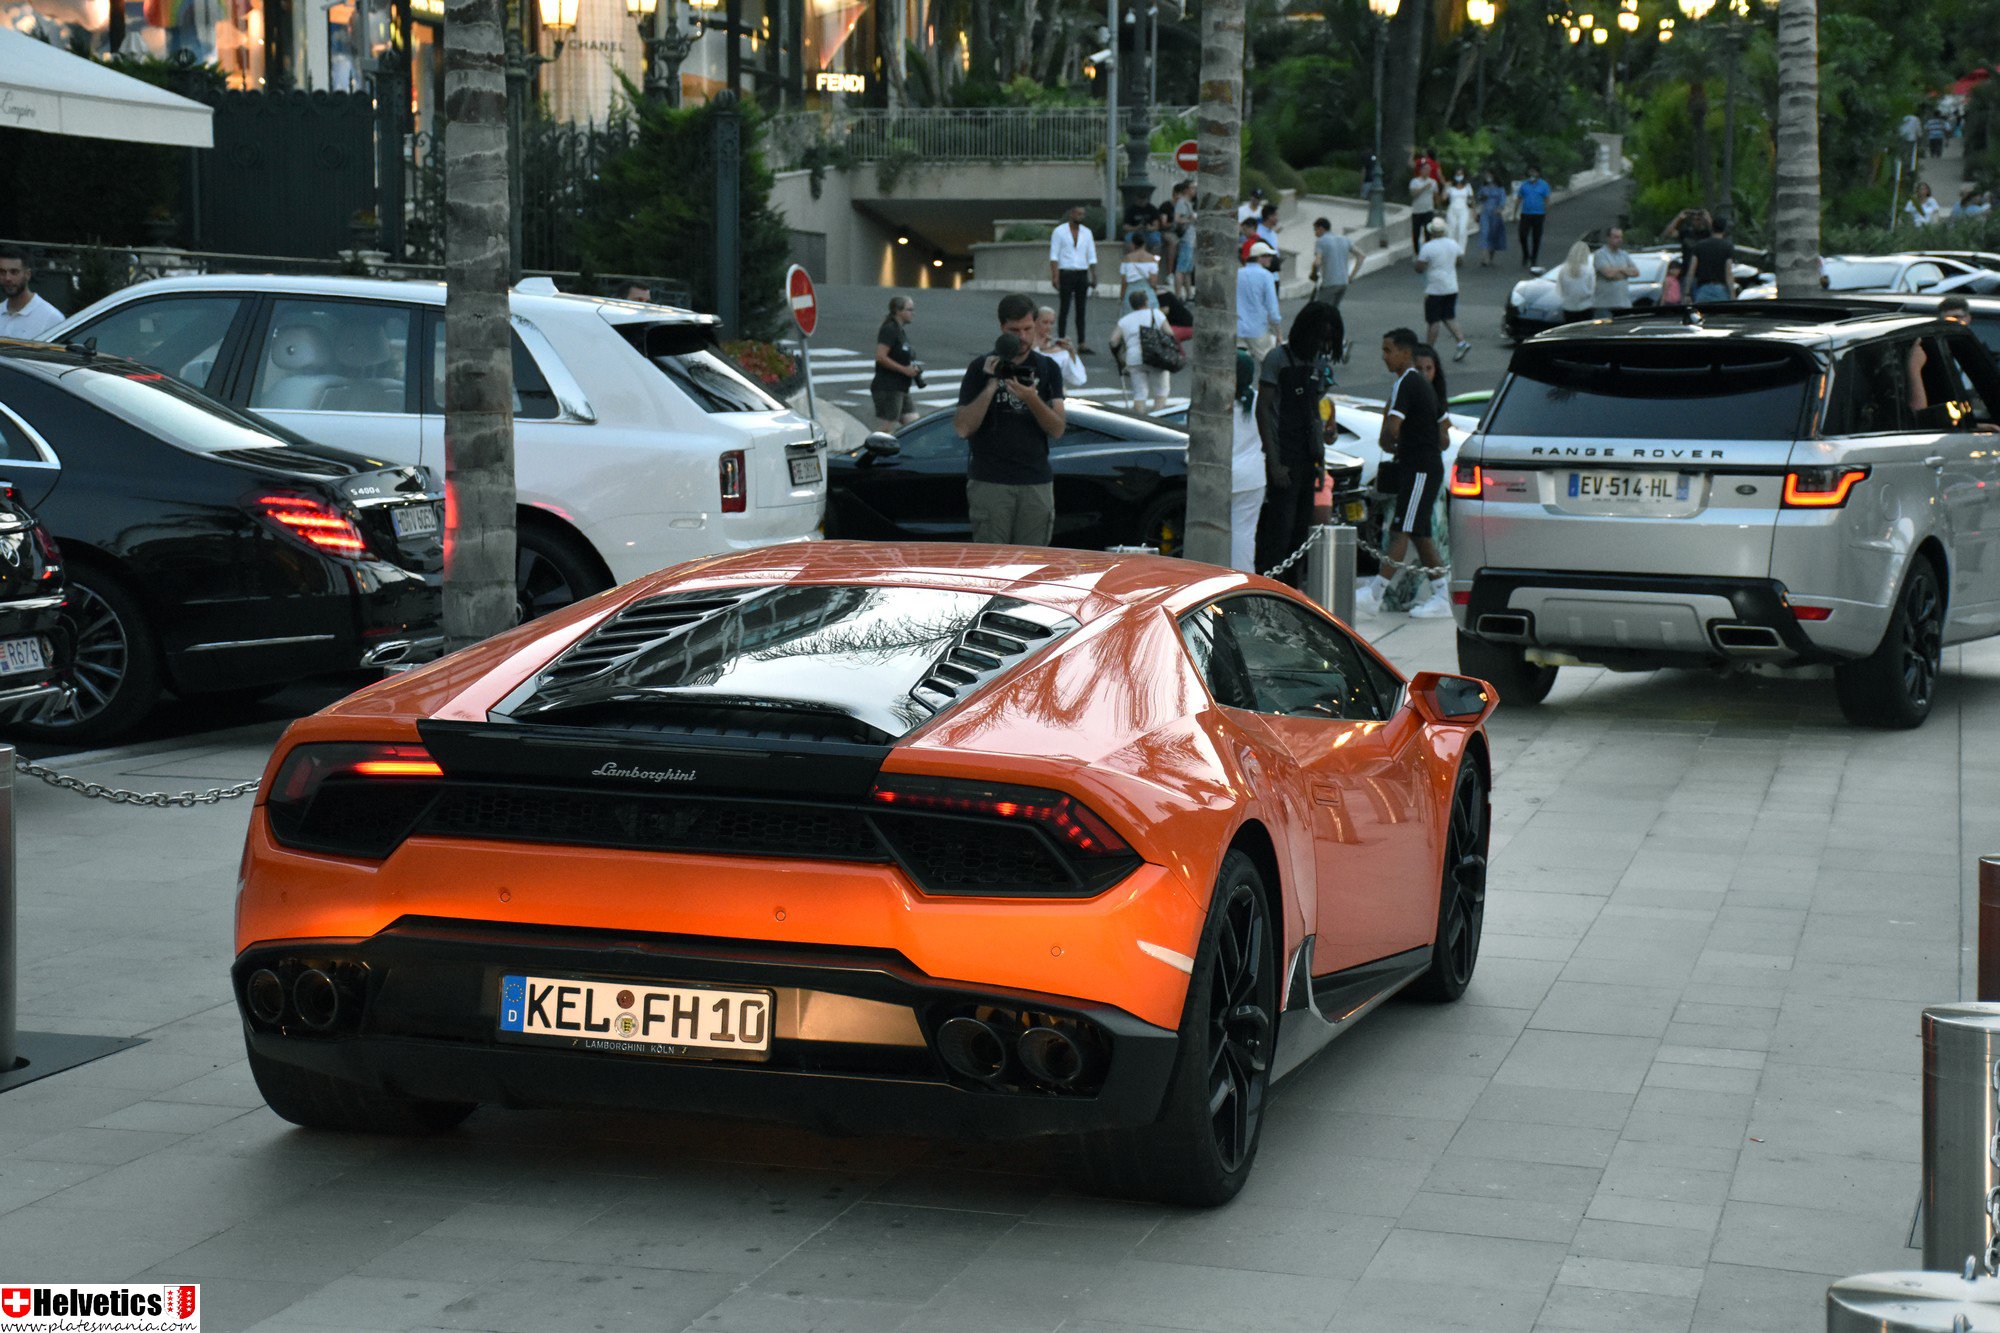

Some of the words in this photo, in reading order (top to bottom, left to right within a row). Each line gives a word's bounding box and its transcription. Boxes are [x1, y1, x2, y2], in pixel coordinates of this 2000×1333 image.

[568, 40, 625, 52] CHANEL
[816, 73, 865, 93] FENDI
[1532, 447, 1615, 457] RANGE
[1633, 449, 1723, 458] ROVER
[1581, 476, 1672, 498] EV-514-HL
[592, 762, 696, 783] Lamborghini
[508, 1009, 518, 1023] D
[527, 983, 610, 1033] KEL
[642, 993, 700, 1040] FH
[709, 998, 766, 1043] 10
[585, 1040, 645, 1053] LAMBORGHINI
[650, 1043, 675, 1055] KÖLN
